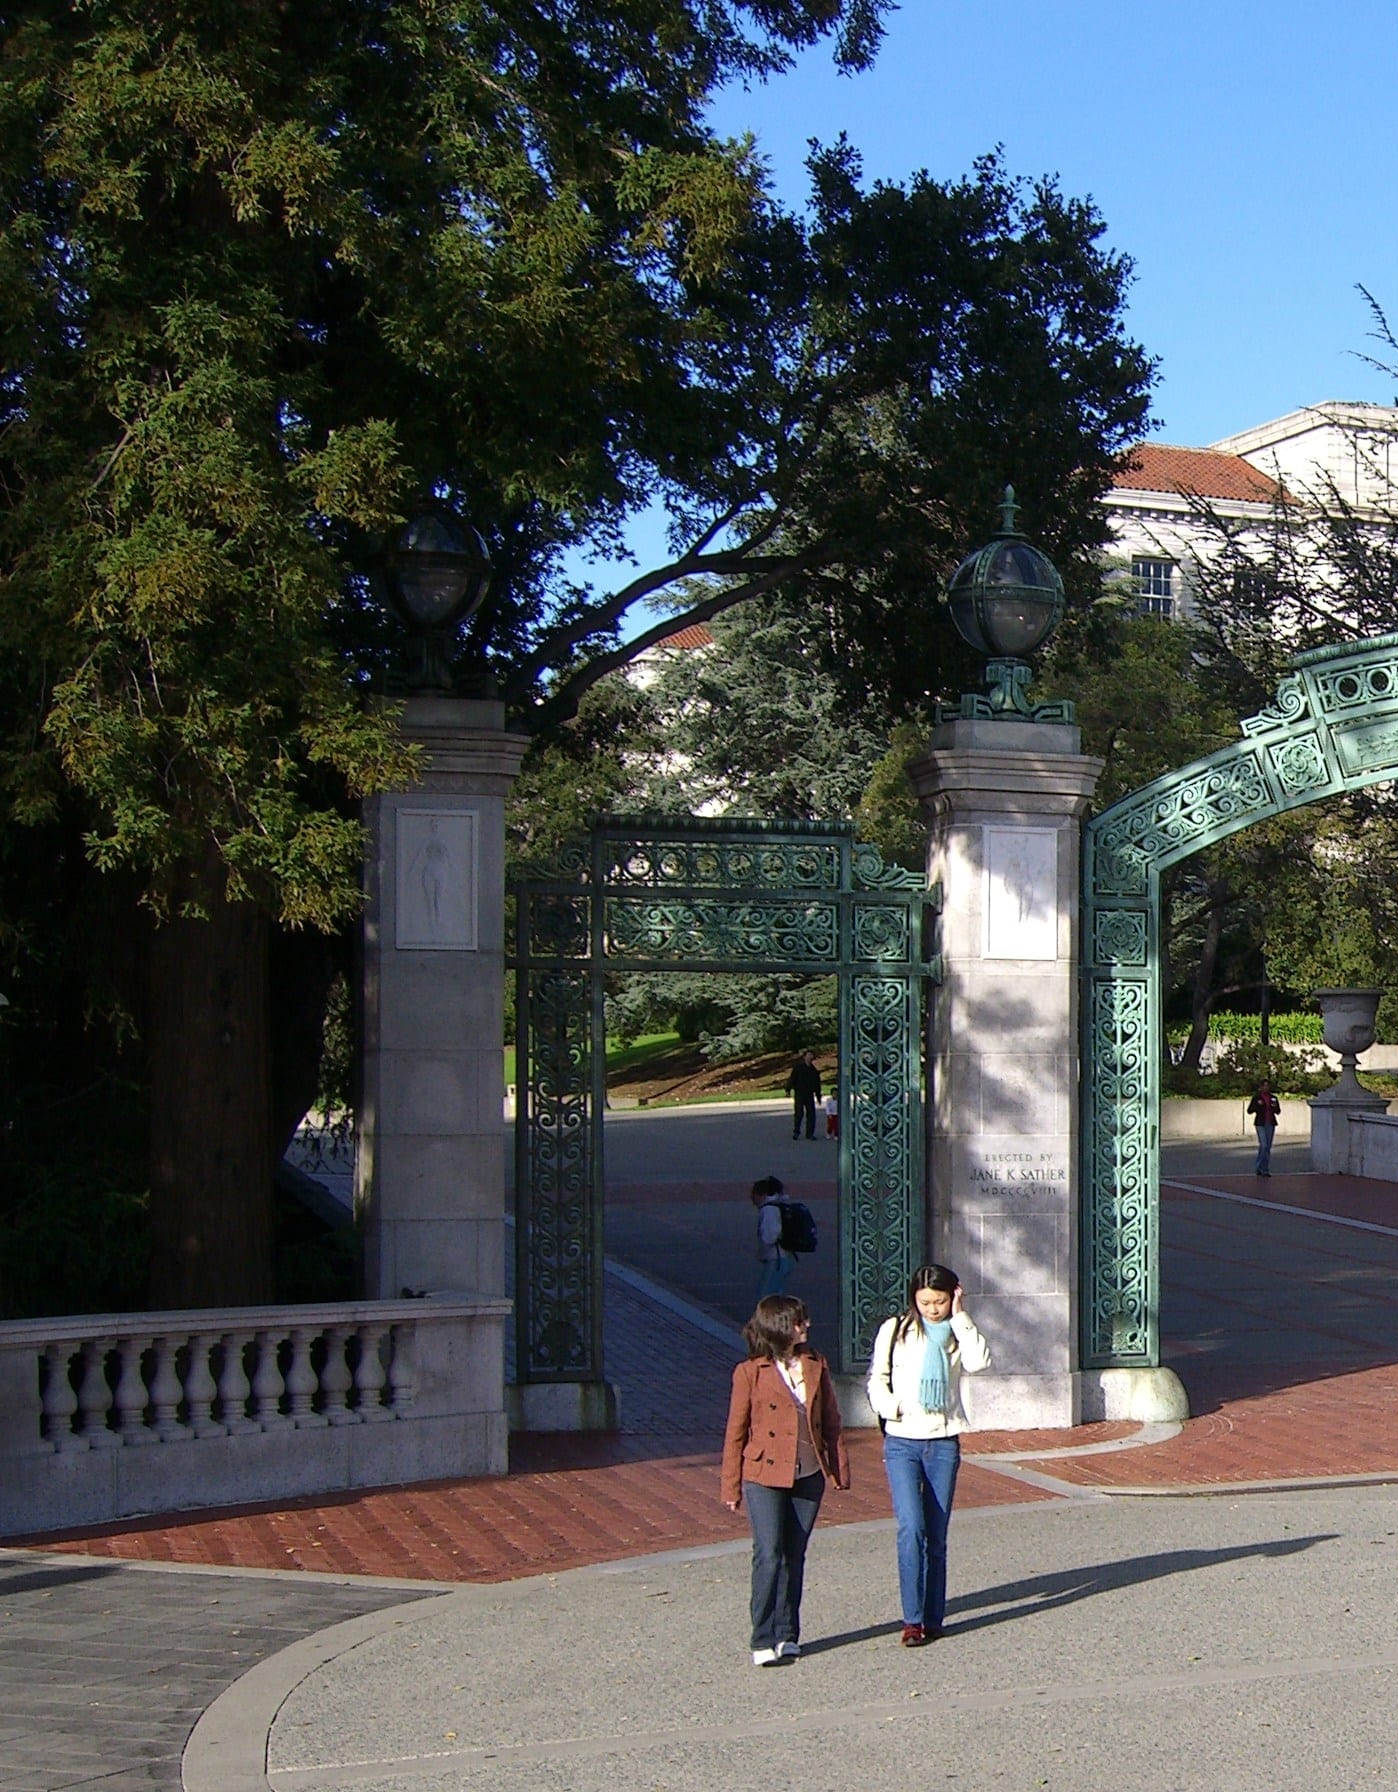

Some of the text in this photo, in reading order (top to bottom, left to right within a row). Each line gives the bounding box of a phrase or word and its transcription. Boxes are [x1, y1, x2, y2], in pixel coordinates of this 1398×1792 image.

[985, 1153, 1053, 1162] ERECTED BY
[969, 1168, 1001, 1181] JANE
[1020, 1168, 1065, 1181] SATHER
